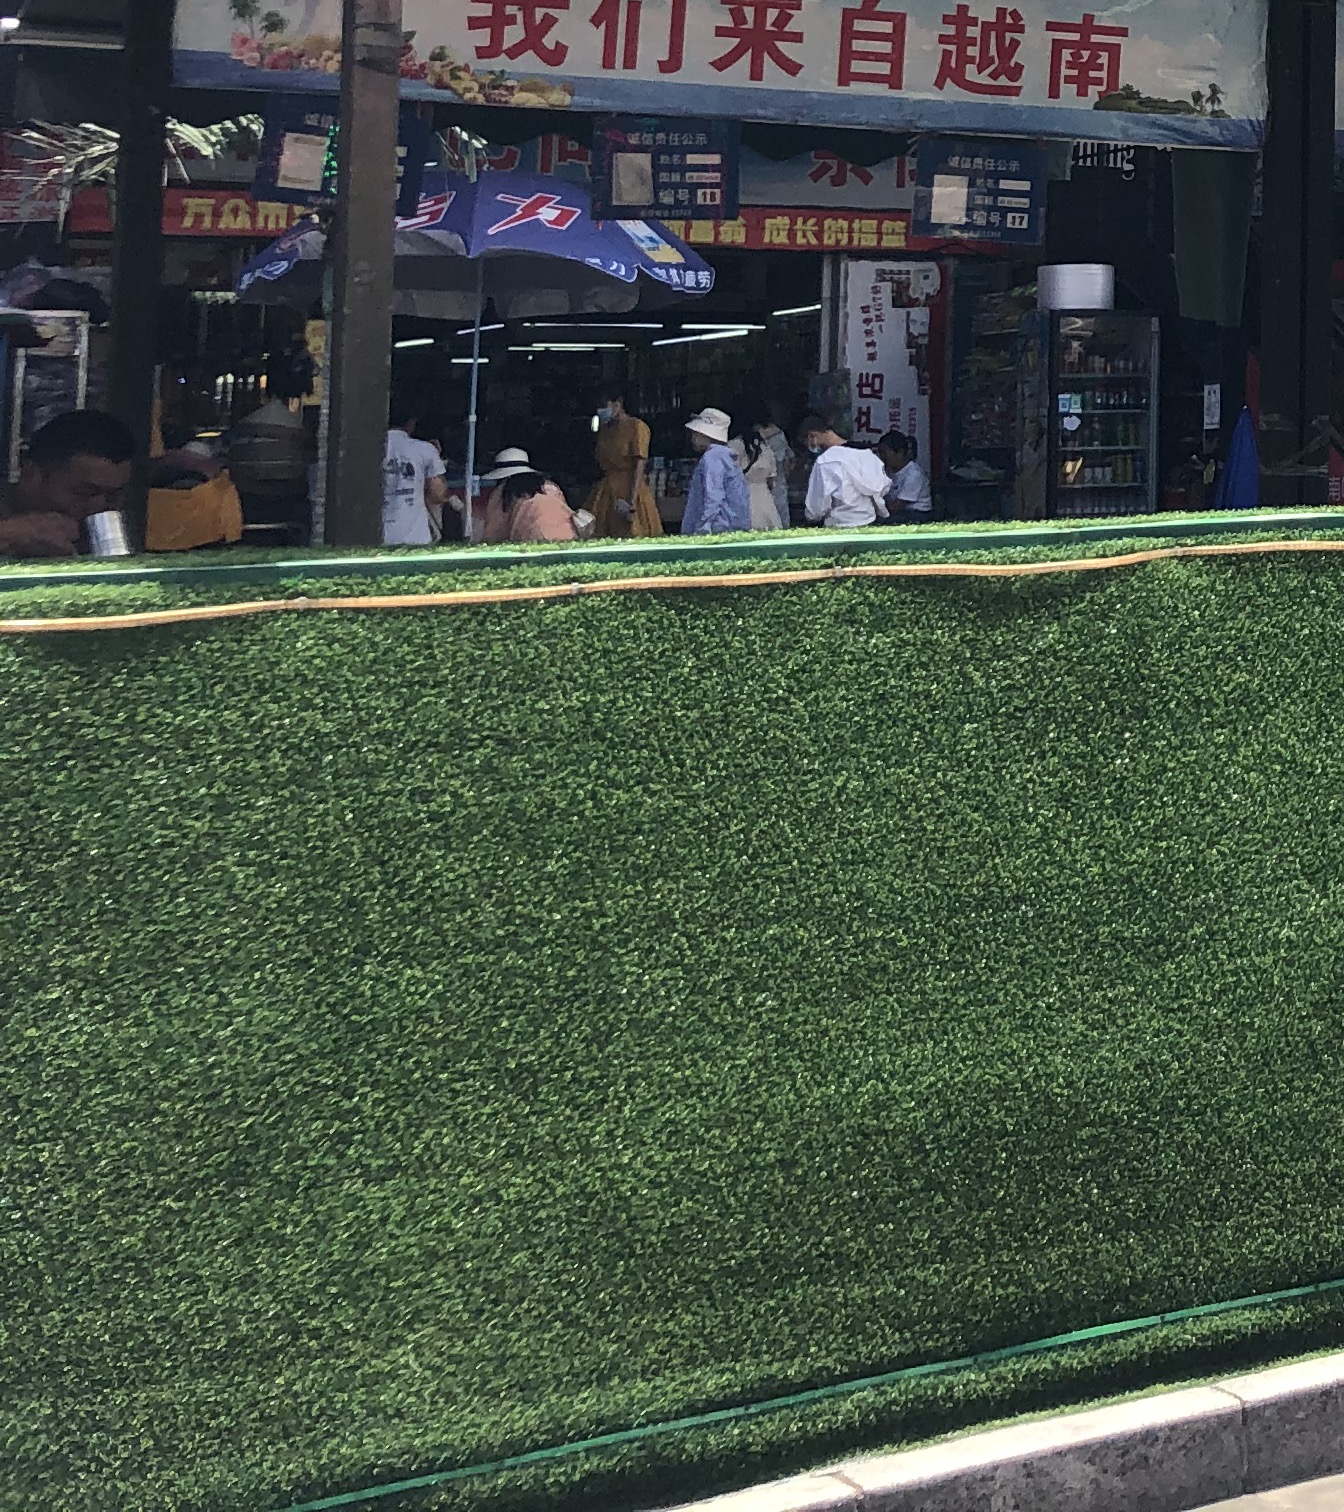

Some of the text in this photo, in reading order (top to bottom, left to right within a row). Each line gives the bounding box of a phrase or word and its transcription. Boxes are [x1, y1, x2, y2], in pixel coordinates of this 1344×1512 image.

[763, 215, 907, 248] 成长的摇篮
